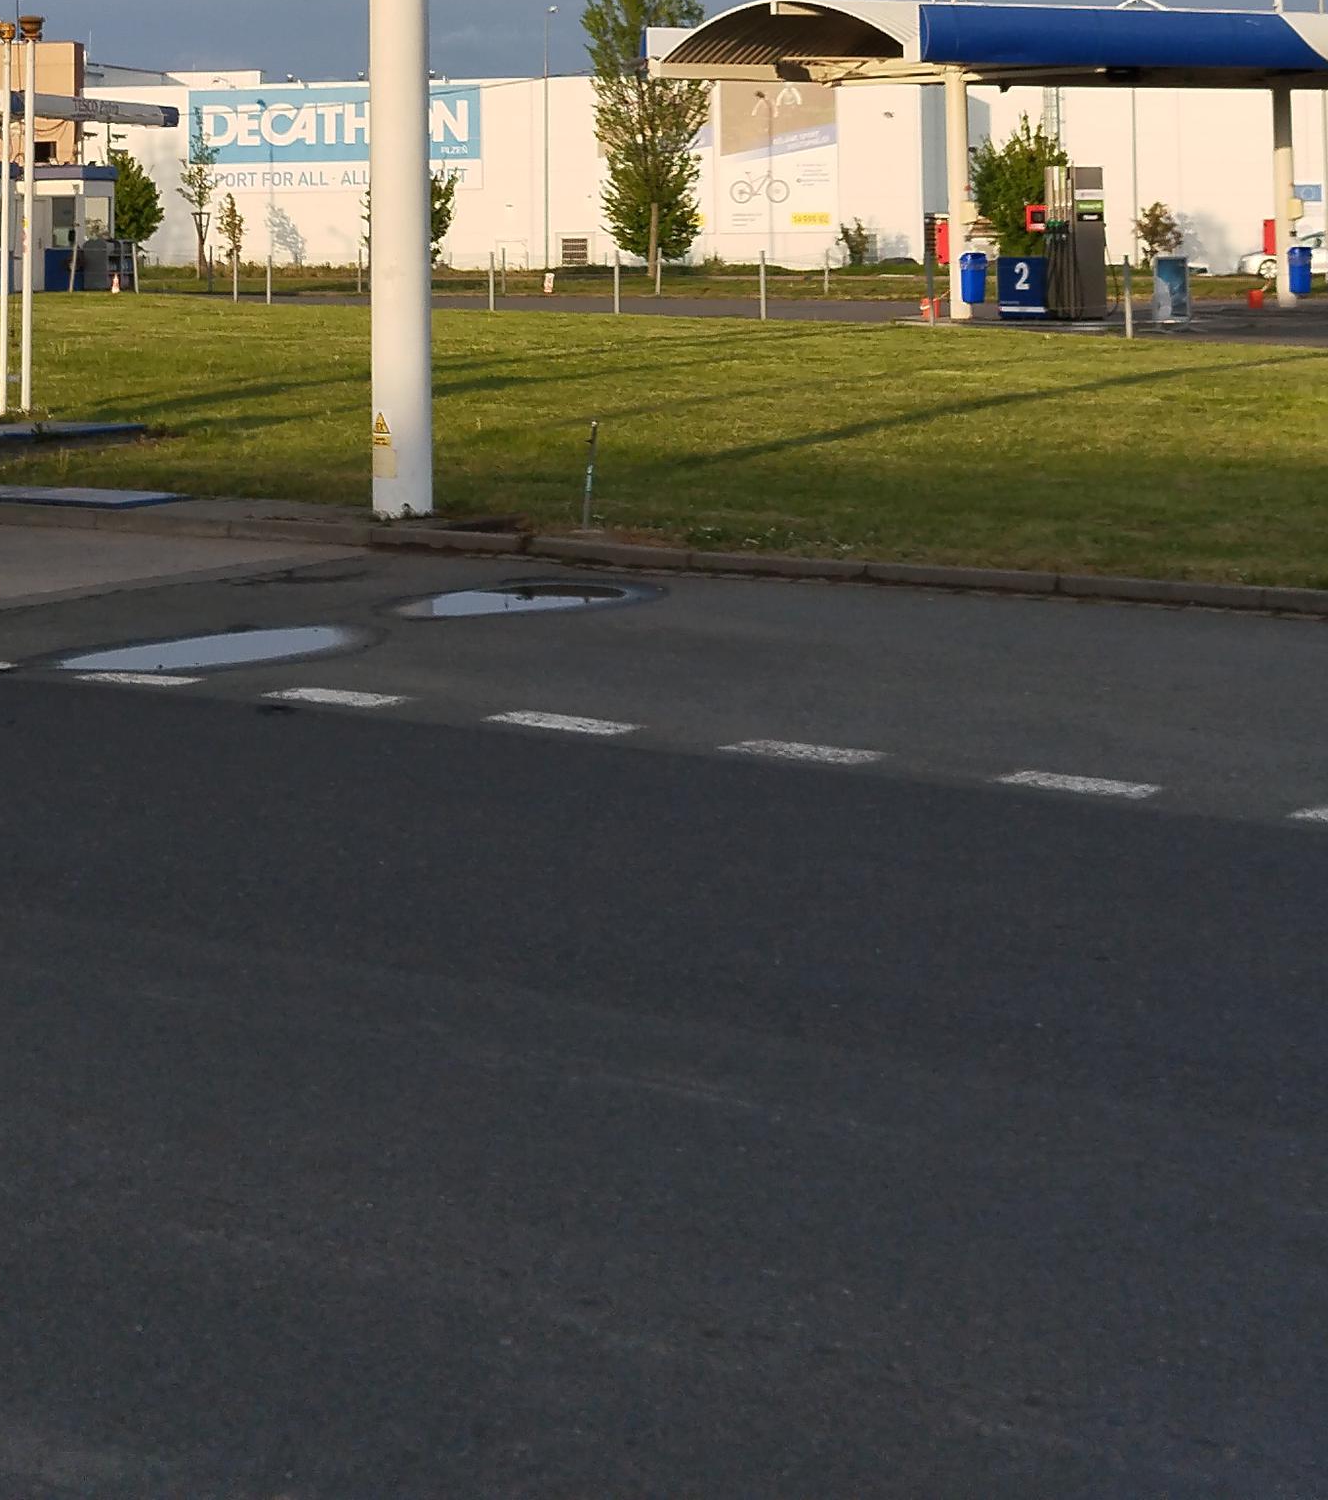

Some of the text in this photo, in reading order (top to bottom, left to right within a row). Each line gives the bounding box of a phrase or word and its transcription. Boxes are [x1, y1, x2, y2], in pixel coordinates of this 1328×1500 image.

[202, 99, 469, 147] DECATHN
[262, 171, 294, 188] FOR
[298, 170, 329, 187] ALL
[340, 169, 370, 186] ALL
[1014, 261, 1030, 290] 2
